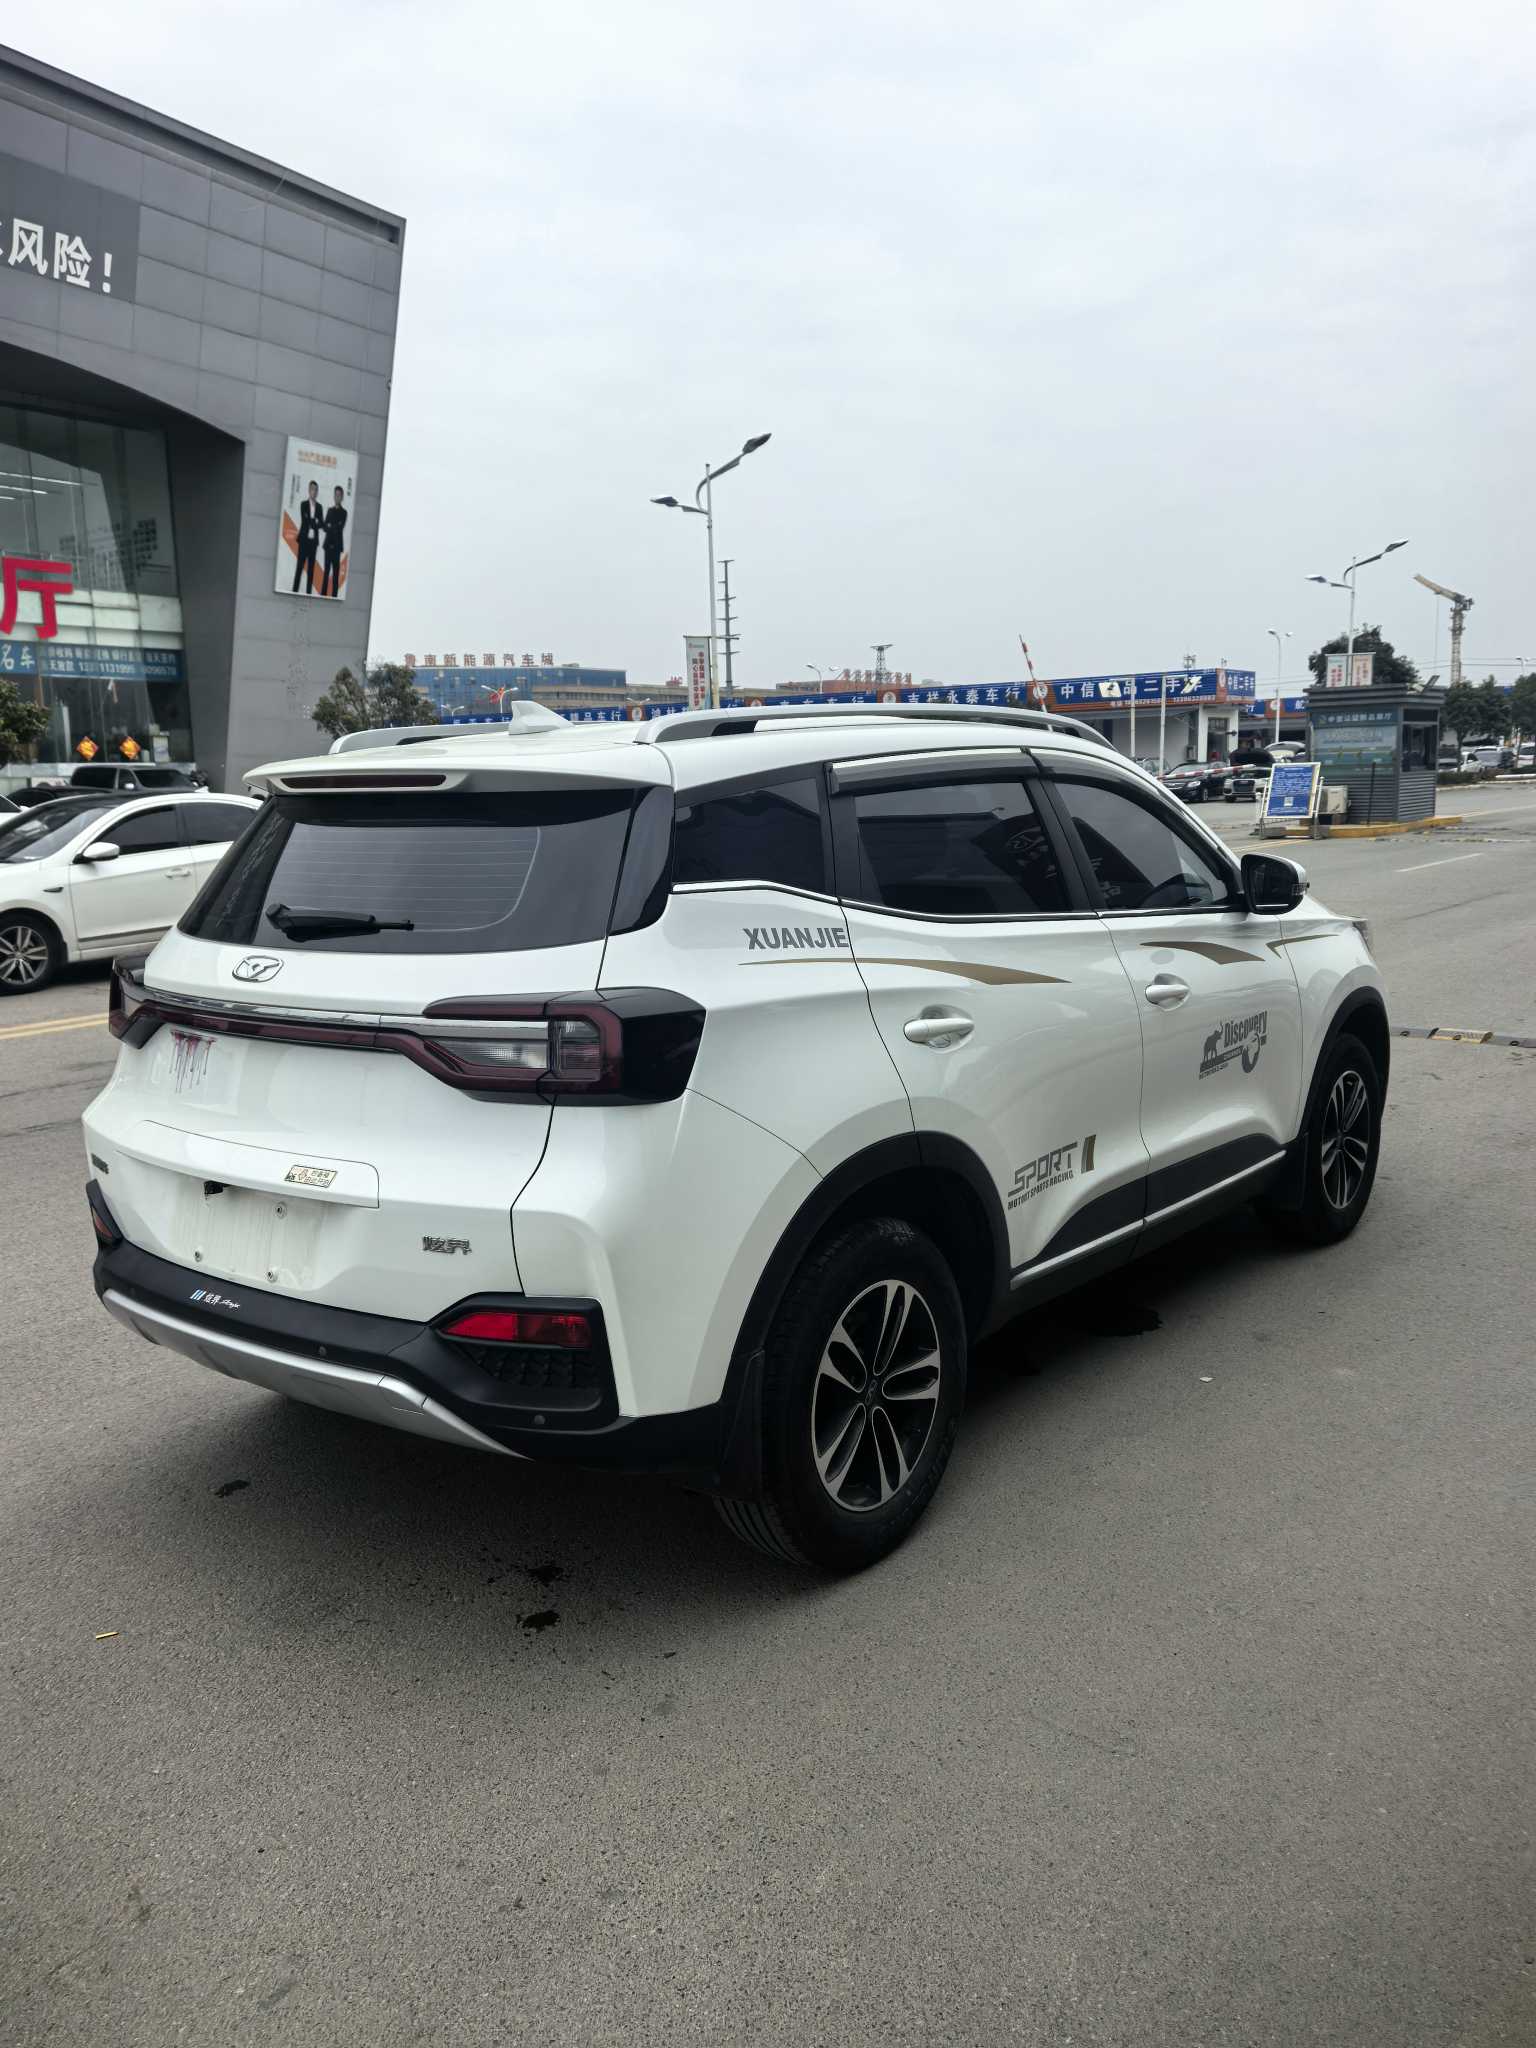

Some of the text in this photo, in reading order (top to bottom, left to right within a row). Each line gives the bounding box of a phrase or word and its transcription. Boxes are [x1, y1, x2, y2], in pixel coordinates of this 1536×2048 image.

[0, 217, 113, 294] 风险！
[0, 556, 74, 640] 厅
[743, 927, 849, 950] XUANJIE
[1224, 1010, 1268, 1048] Discovery
[1008, 1142, 1078, 1198] SPORT
[1050, 1169, 1075, 1187] RACING
